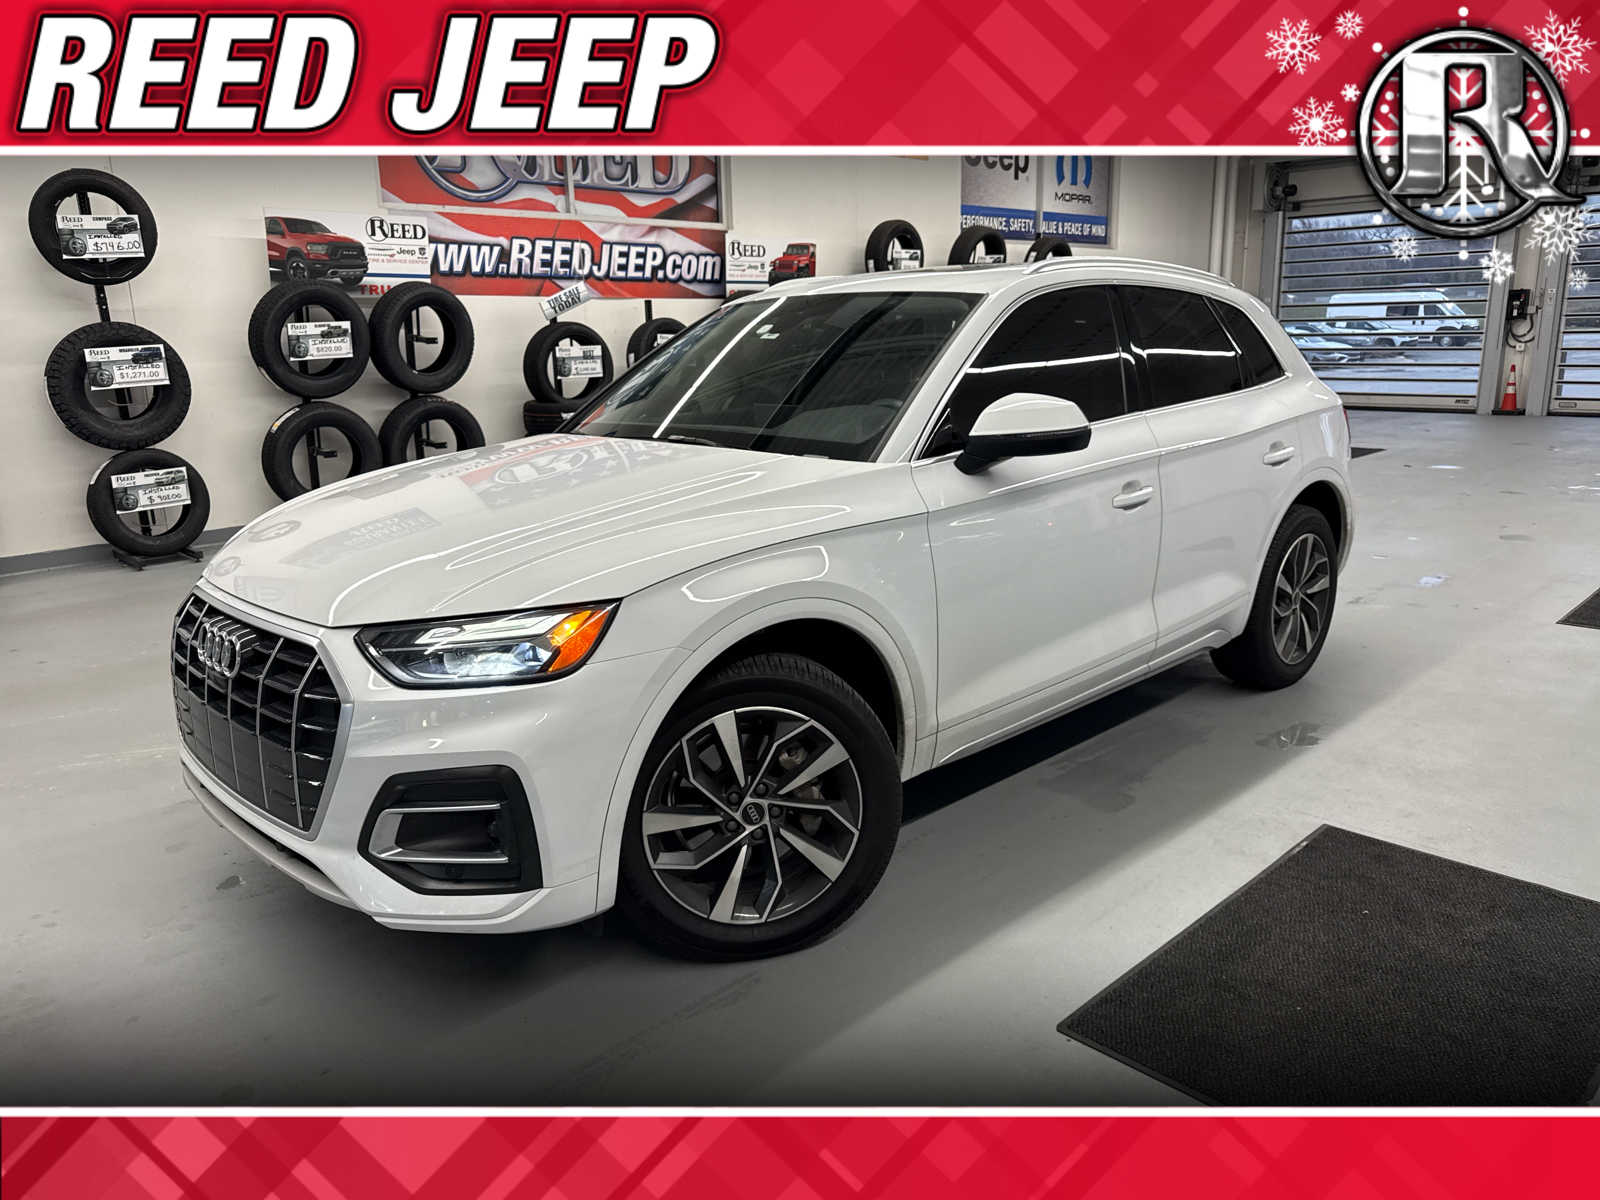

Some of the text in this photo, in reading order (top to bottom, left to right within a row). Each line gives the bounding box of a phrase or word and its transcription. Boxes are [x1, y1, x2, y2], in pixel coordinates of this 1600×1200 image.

[1054, 191, 1092, 204] MOPAR
[365, 216, 427, 242] REED
[1009, 218, 1035, 234] SAFETY,
[1064, 223, 1082, 235] PEACE
[1083, 225, 1090, 236] OF
[1092, 225, 1106, 237] MIND
[396, 247, 416, 256] Jeep
[729, 240, 766, 260] REED
[564, 286, 581, 301] SALE
[551, 295, 582, 314] TODAY
